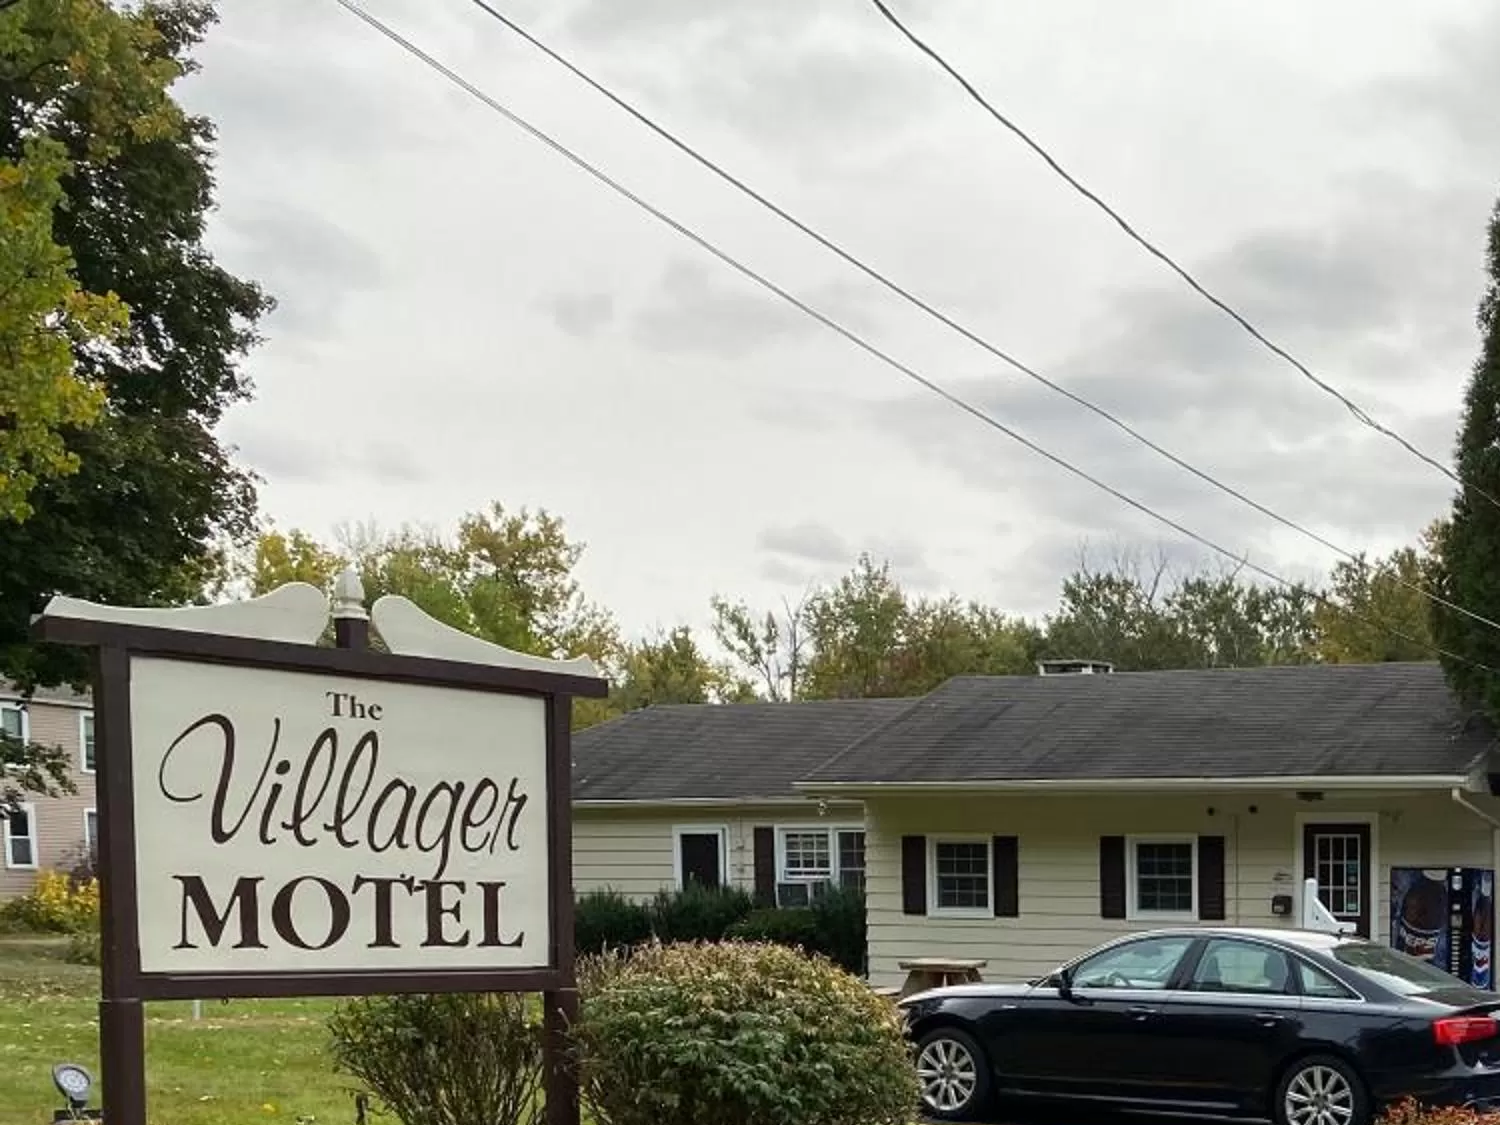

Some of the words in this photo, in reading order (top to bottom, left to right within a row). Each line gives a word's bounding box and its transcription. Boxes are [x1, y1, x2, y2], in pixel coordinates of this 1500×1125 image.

[325, 691, 383, 721] The
[159, 713, 529, 881] Villager
[172, 874, 525, 951] MOTEL
